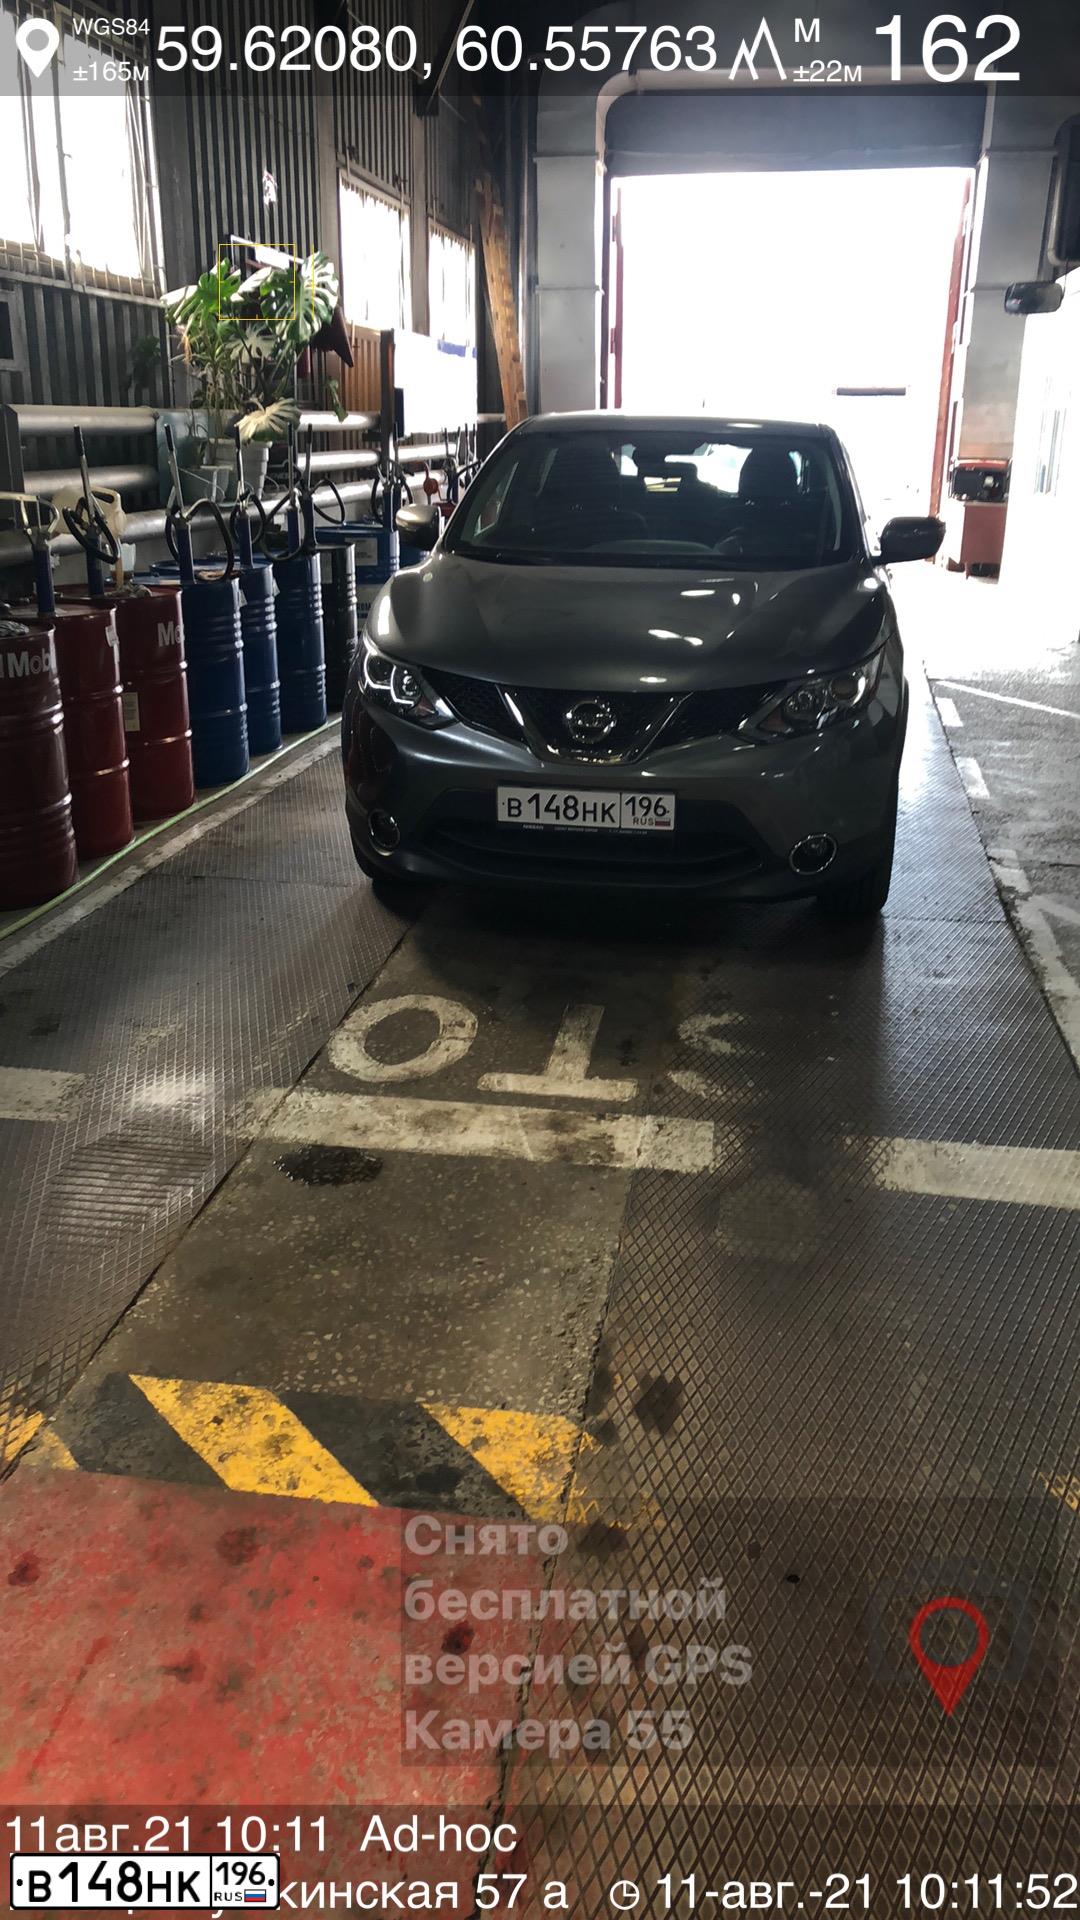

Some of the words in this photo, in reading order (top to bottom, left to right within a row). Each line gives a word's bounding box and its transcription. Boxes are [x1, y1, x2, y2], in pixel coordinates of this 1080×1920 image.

[507, 793, 616, 823] В148НК
[624, 796, 668, 817] 196
[632, 816, 655, 826] RUS
